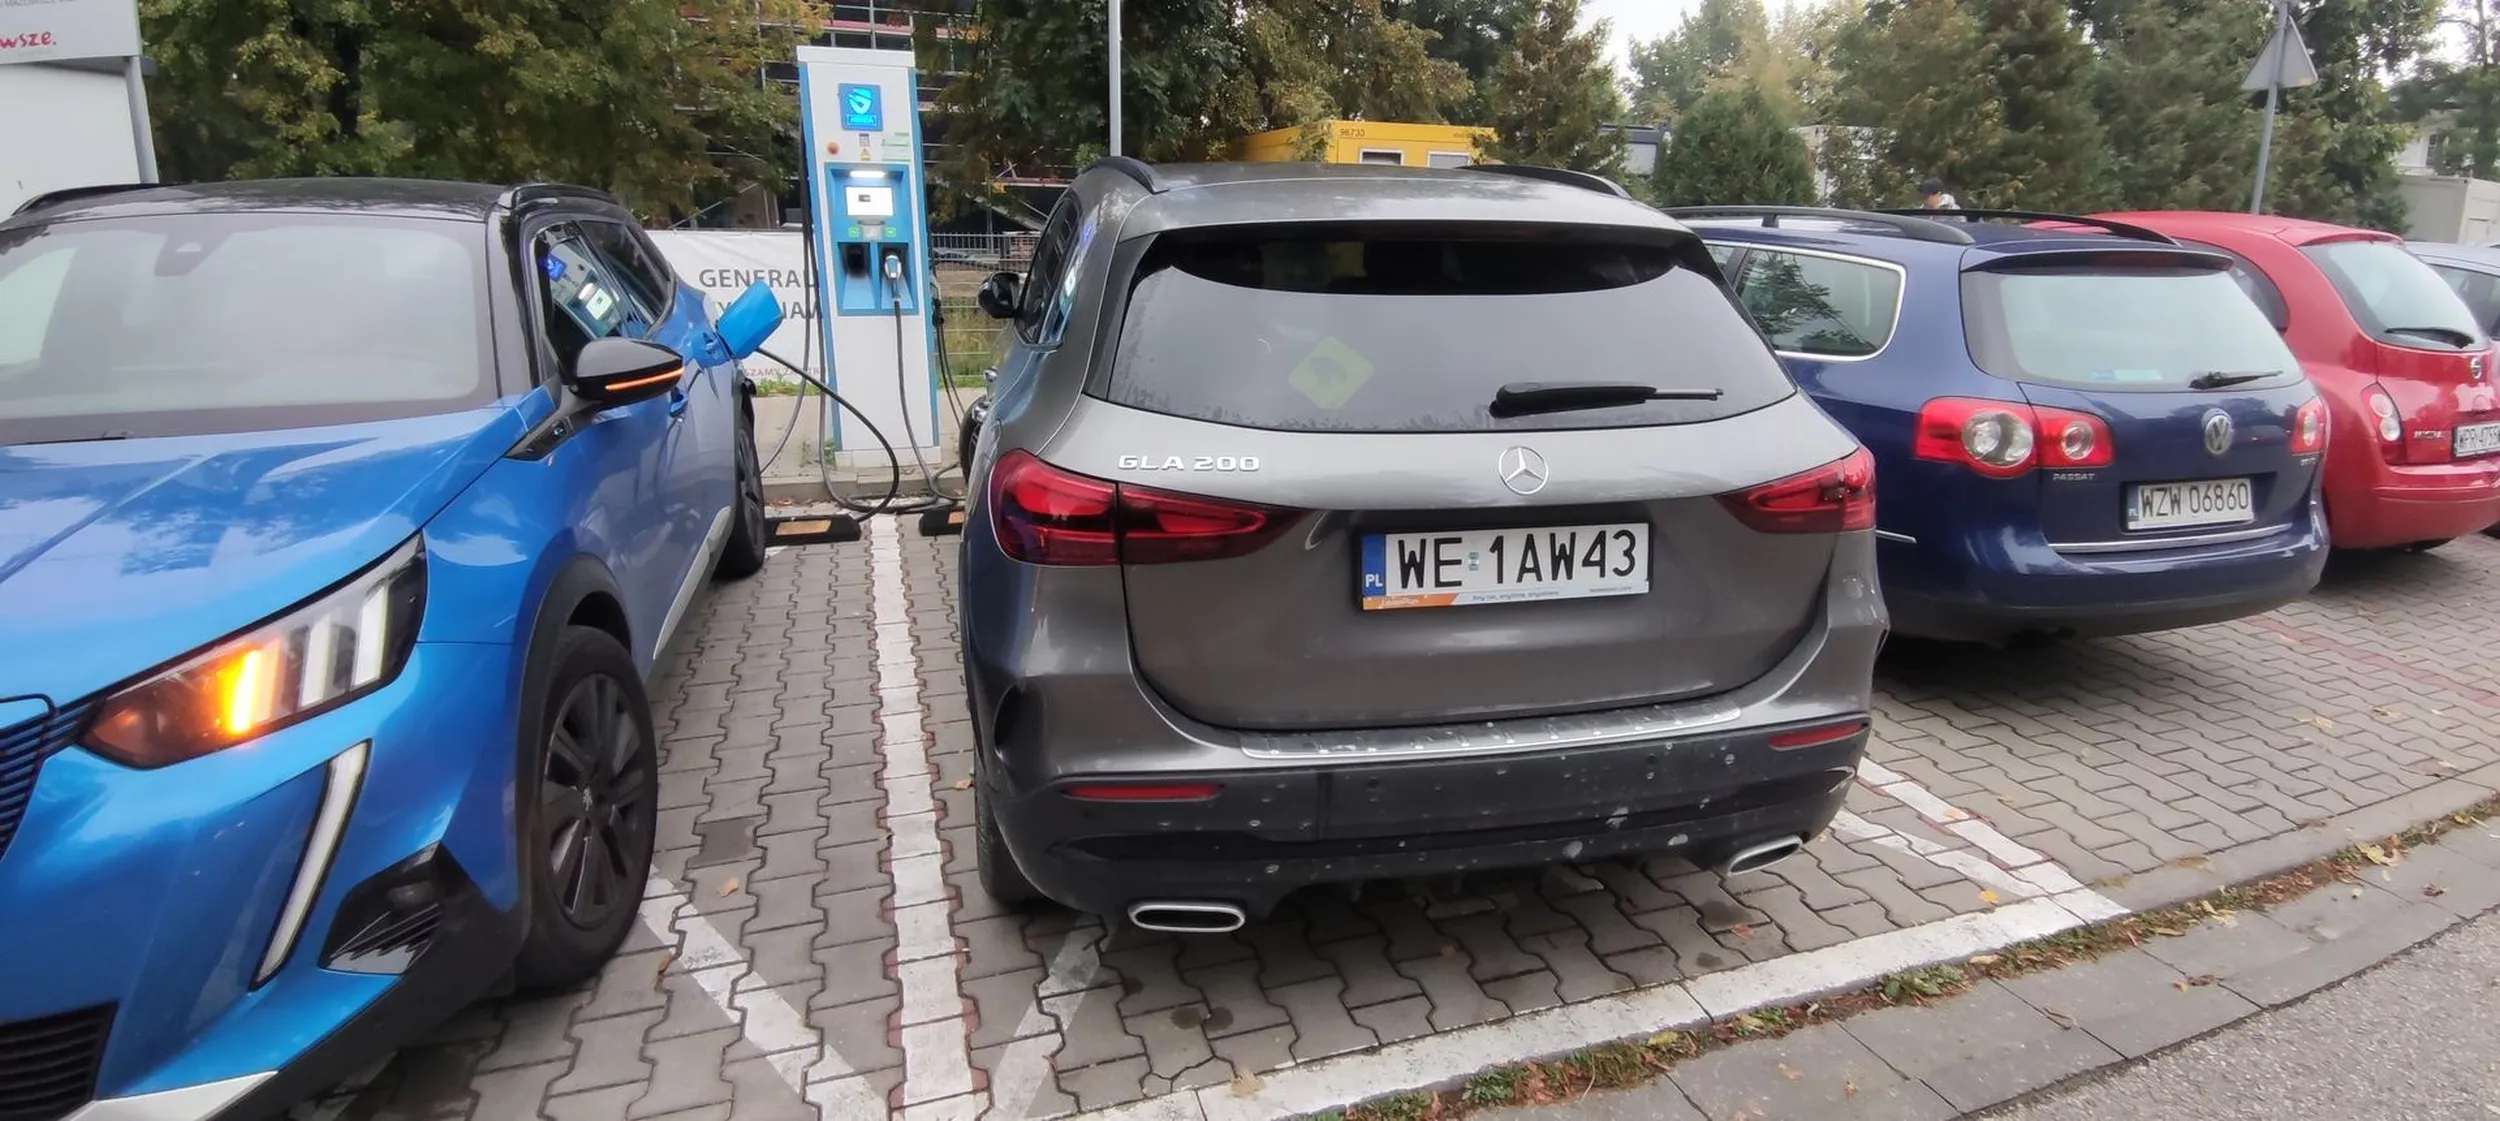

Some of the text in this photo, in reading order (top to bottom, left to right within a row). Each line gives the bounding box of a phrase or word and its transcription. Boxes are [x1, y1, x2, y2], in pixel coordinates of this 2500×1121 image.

[1118, 455, 1260, 472] GLA 200
[2053, 473, 2095, 481] PASSAT
[2140, 482, 2250, 518] WZW 06860
[1398, 529, 1636, 589] WE 1AW43
[1365, 573, 1383, 588] PL
